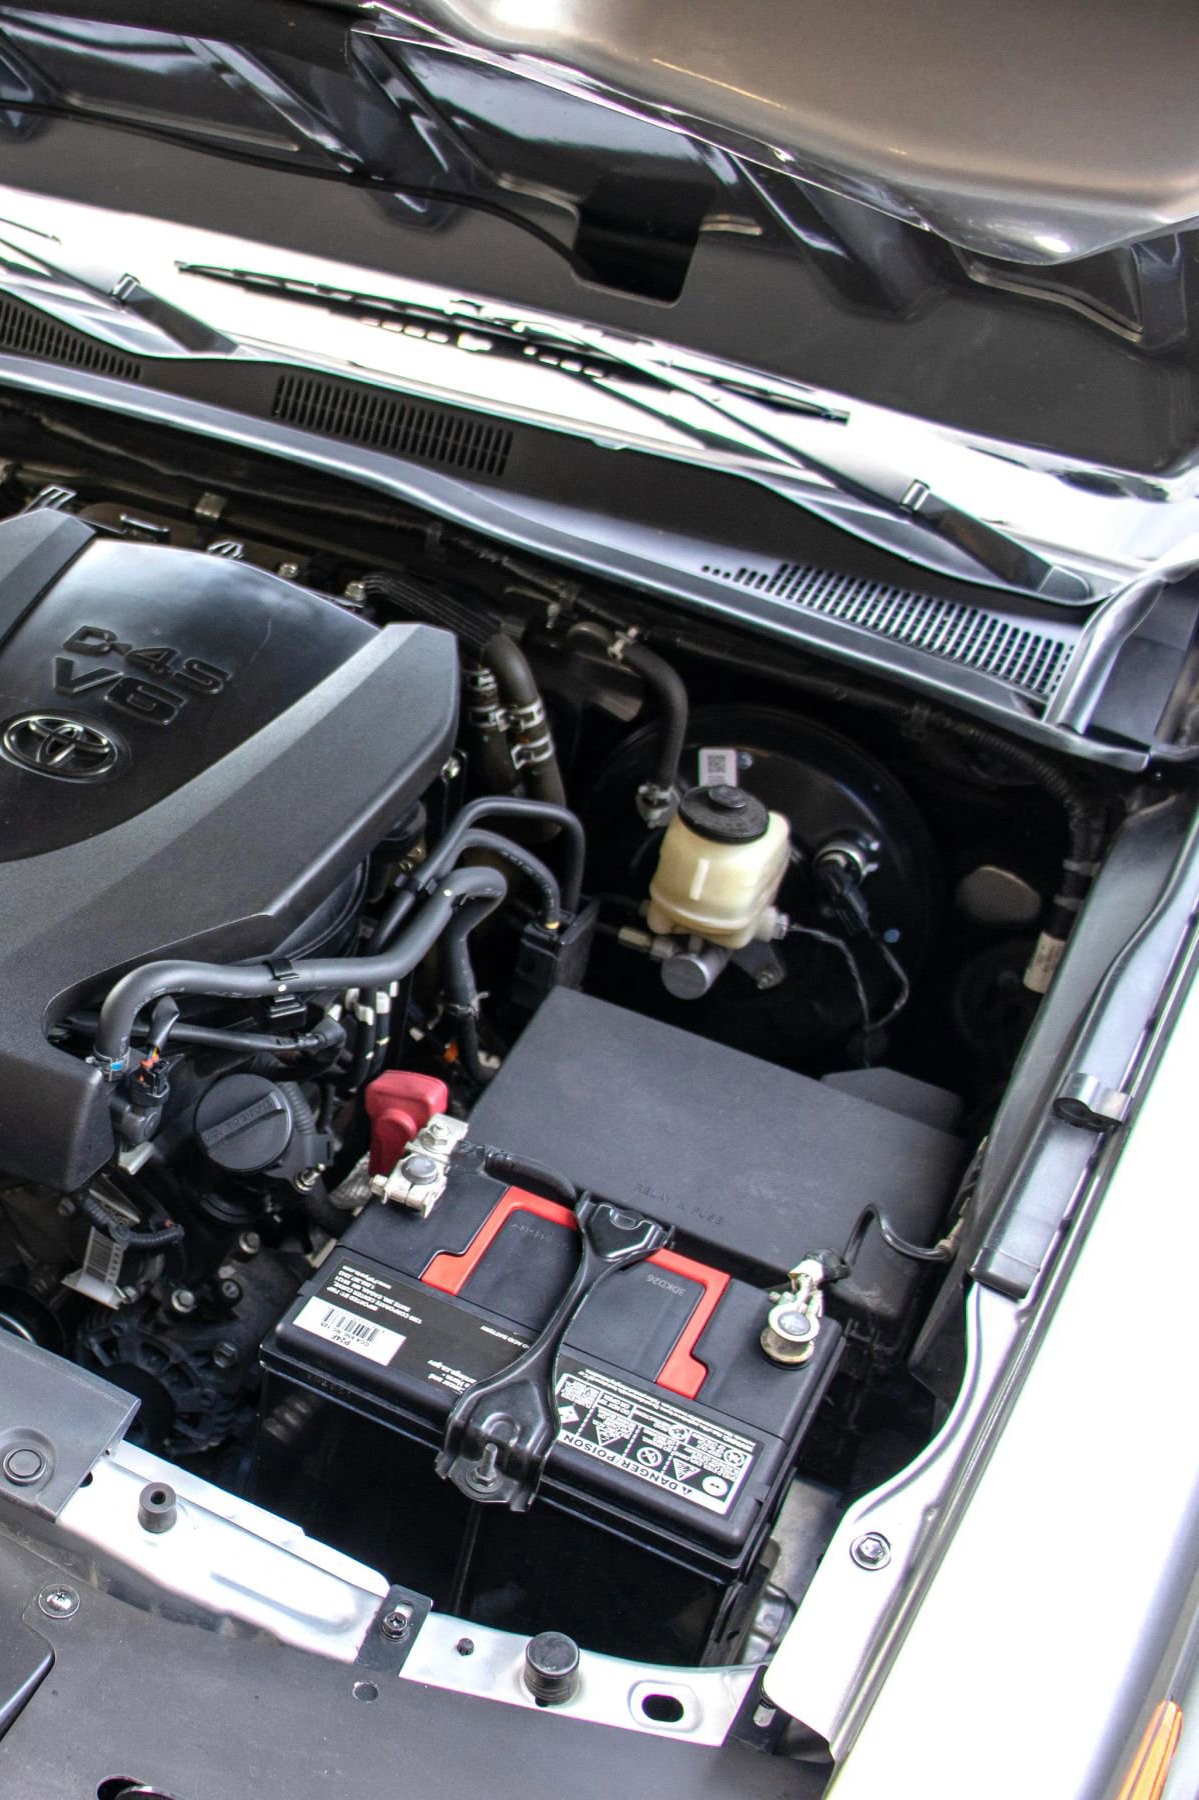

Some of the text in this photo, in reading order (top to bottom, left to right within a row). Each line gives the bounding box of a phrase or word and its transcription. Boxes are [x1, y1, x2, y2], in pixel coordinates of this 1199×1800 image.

[54, 656, 188, 726] V6
[63, 625, 233, 695] D-4S
[563, 1433, 678, 1491] DANGER/POISON
